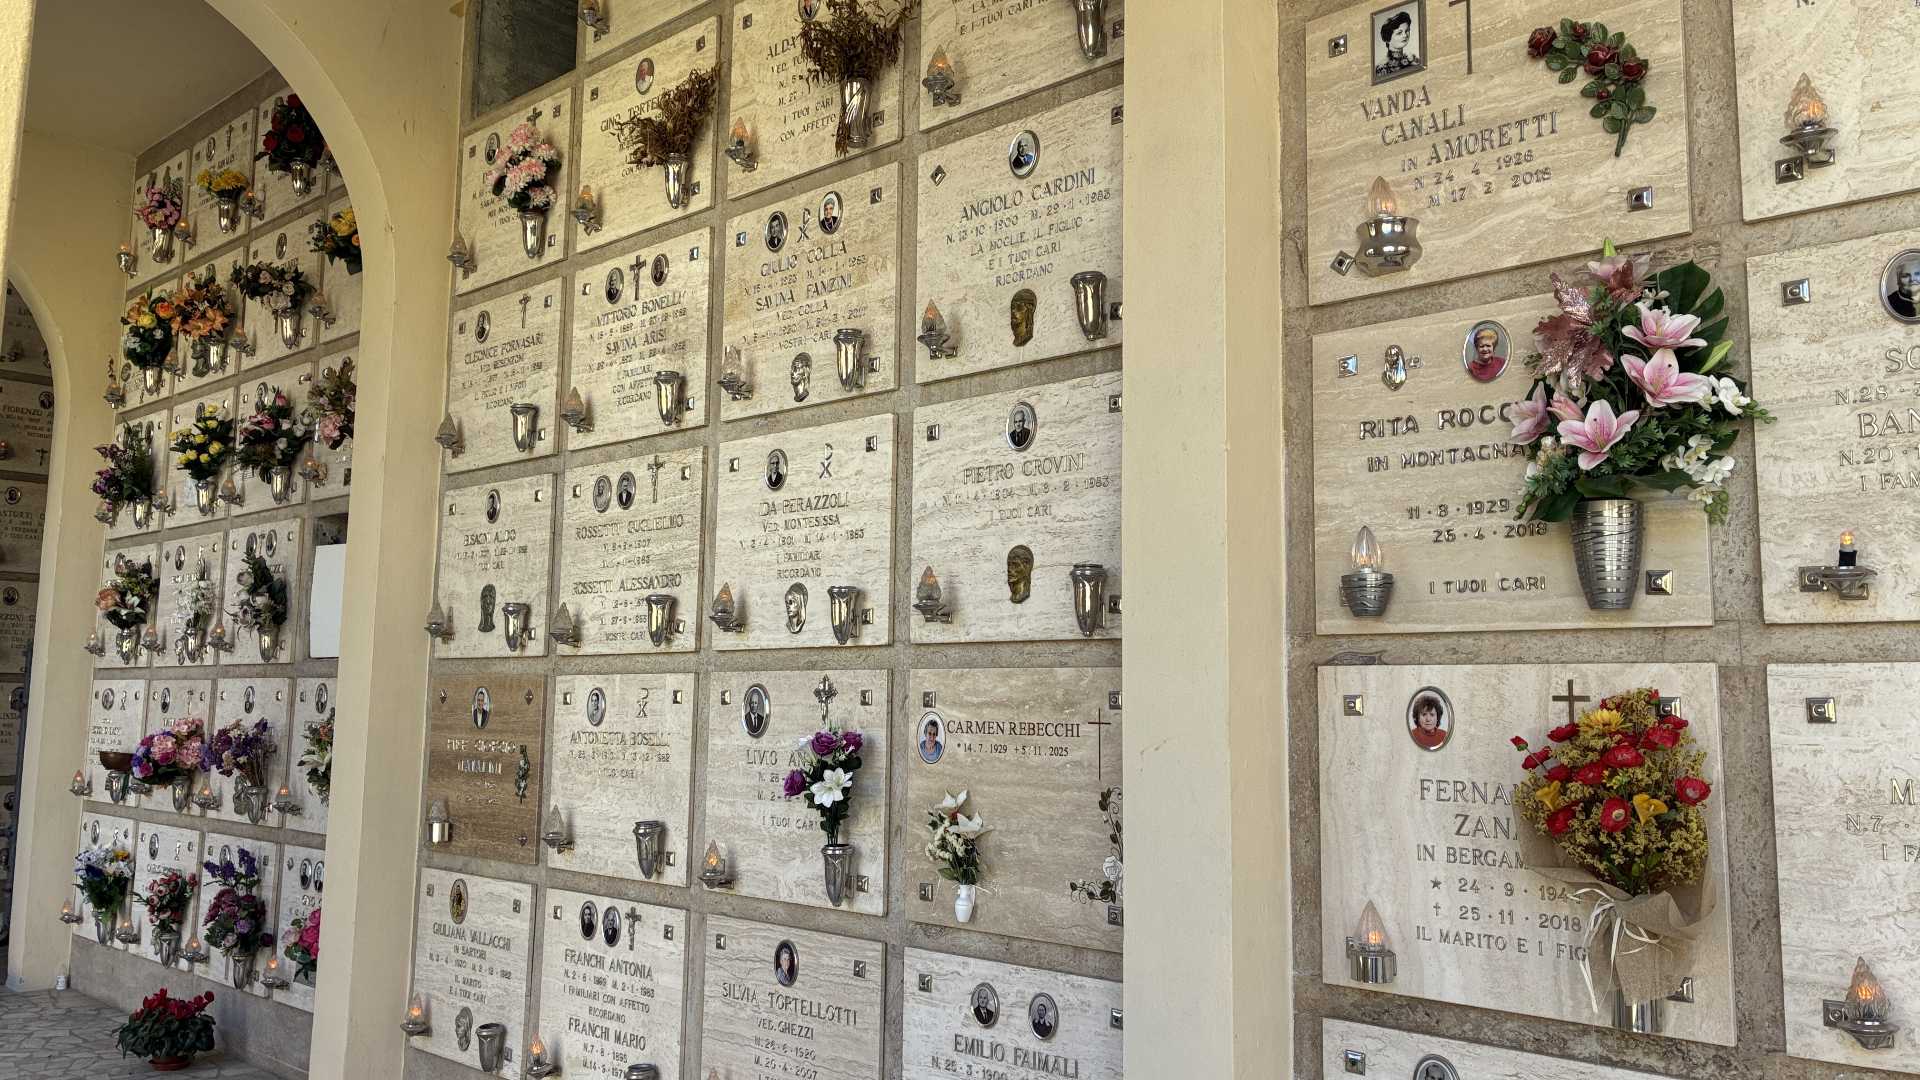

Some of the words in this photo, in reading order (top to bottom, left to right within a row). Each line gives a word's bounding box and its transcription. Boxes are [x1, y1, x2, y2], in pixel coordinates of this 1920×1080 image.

[1360, 85, 1432, 122] VANDA
[1381, 103, 1466, 146] CANALI
[1401, 157, 1418, 172] IN
[1426, 111, 1558, 166] AMORETTI
[1496, 149, 1534, 170] 1926
[1031, 167, 1096, 201] CARDINI
[1359, 414, 1420, 441] RITA
[963, 462, 1014, 485] PIETRO
[1021, 452, 1085, 476] CROVINI
[1367, 455, 1389, 473] IN
[1861, 475, 1866, 491] I
[1466, 499, 1510, 516] 1929
[1504, 522, 1548, 538] 2018
[619, 573, 681, 593] ALESSANDRO
[1430, 581, 1436, 595] I
[1443, 579, 1488, 594] TUOI
[1499, 576, 1546, 592] CARI
[946, 719, 1005, 736] CARMEN
[1008, 722, 1081, 738] REBECCHI
[1454, 813, 1518, 841] ZAN
[1416, 844, 1436, 862] IN
[1458, 877, 1480, 894] 24
[1504, 882, 1514, 897] 9
[1538, 885, 1581, 905] 194
[1459, 905, 1481, 921] 25
[1498, 909, 1514, 925] 11
[1538, 913, 1582, 933] 2018
[1416, 925, 1432, 942] IL
[1439, 928, 1507, 951] MARITO
[1517, 938, 1528, 954] E
[1538, 941, 1543, 956] I
[609, 958, 653, 981] ANTONIA
[768, 991, 857, 1026] TORTELLOTTI
[568, 1017, 610, 1042] FRANCHI
[614, 1028, 647, 1052] MARIO
[778, 1020, 814, 1041] GHEZZI
[954, 1033, 1005, 1063] EMILIO
[1014, 1047, 1079, 1080] FAIMALI
